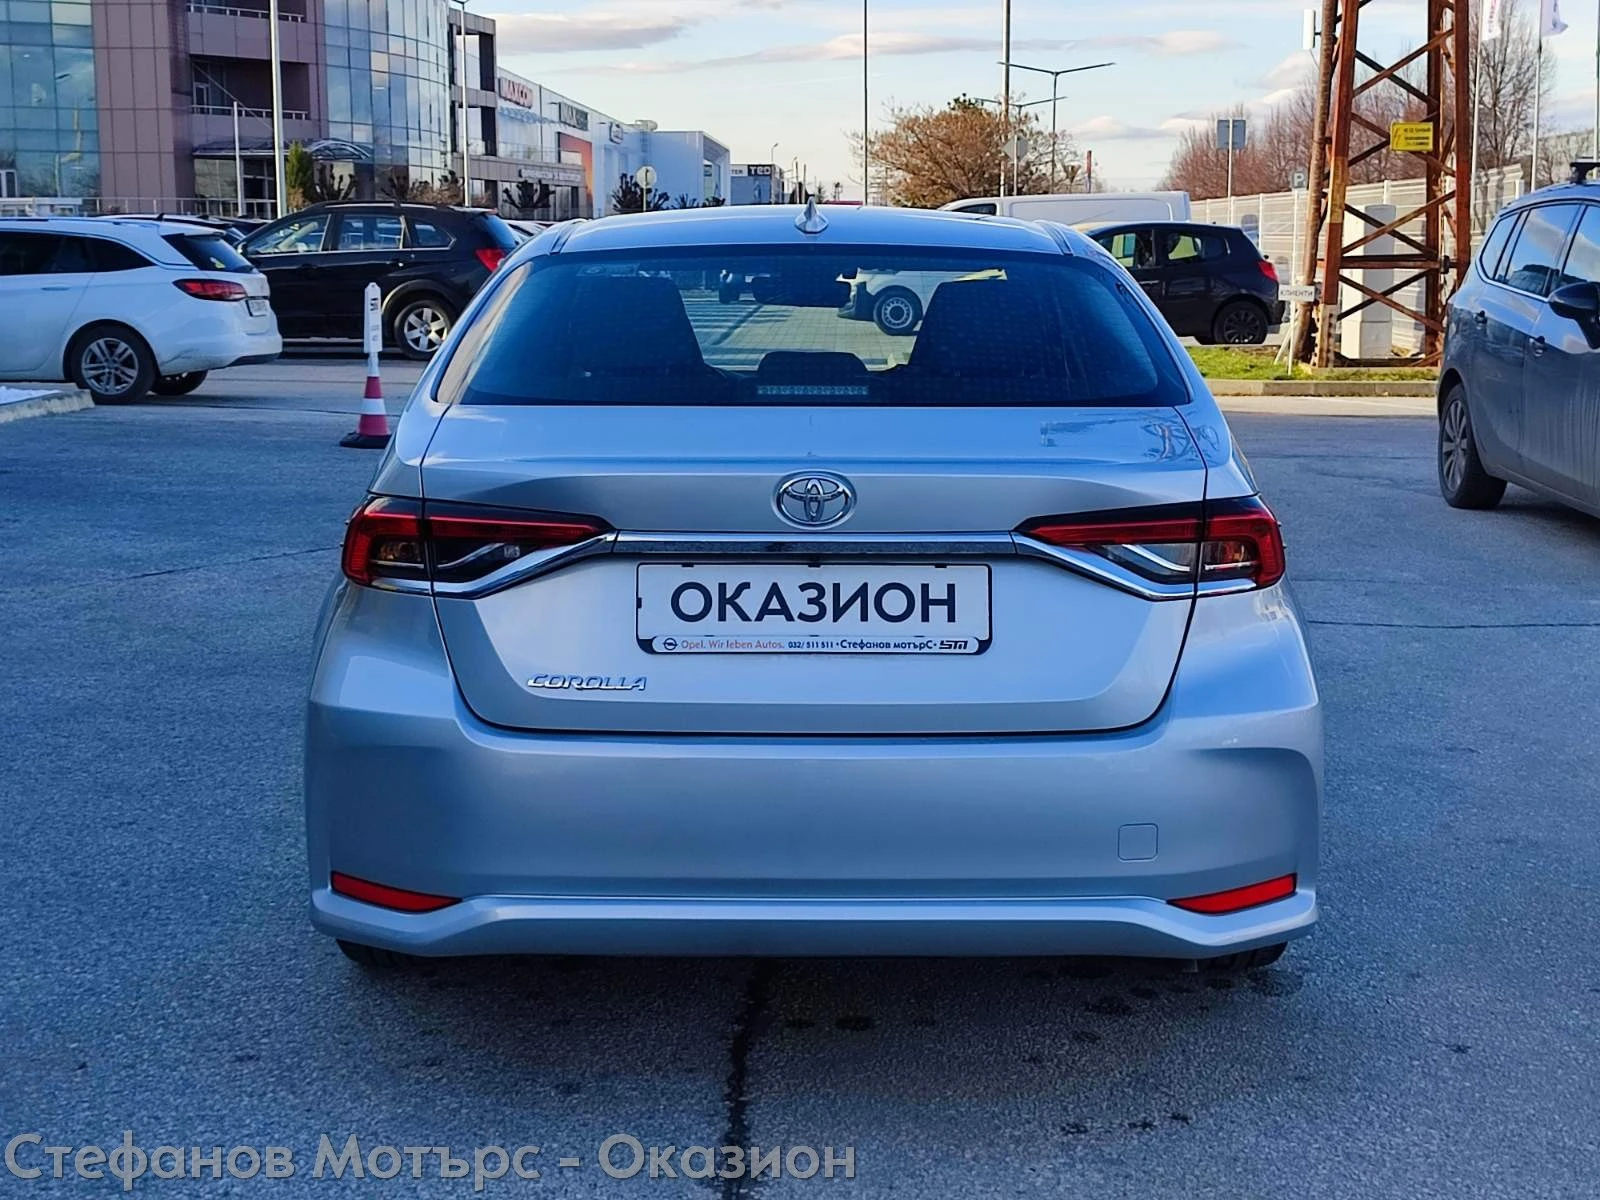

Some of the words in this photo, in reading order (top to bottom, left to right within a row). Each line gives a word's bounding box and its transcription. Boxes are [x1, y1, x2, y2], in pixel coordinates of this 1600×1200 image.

[1294, 173, 1304, 188] P
[671, 581, 956, 623] ОКАЗИОН
[681, 640, 706, 650] Opel.
[708, 640, 724, 649] Wir
[726, 640, 753, 649] leben
[755, 641, 785, 649] Autos.
[788, 641, 804, 649] 032/
[806, 641, 819, 649] 511
[821, 641, 834, 649] 511
[840, 639, 891, 650] Стефанов
[527, 674, 648, 691] COROLLA
